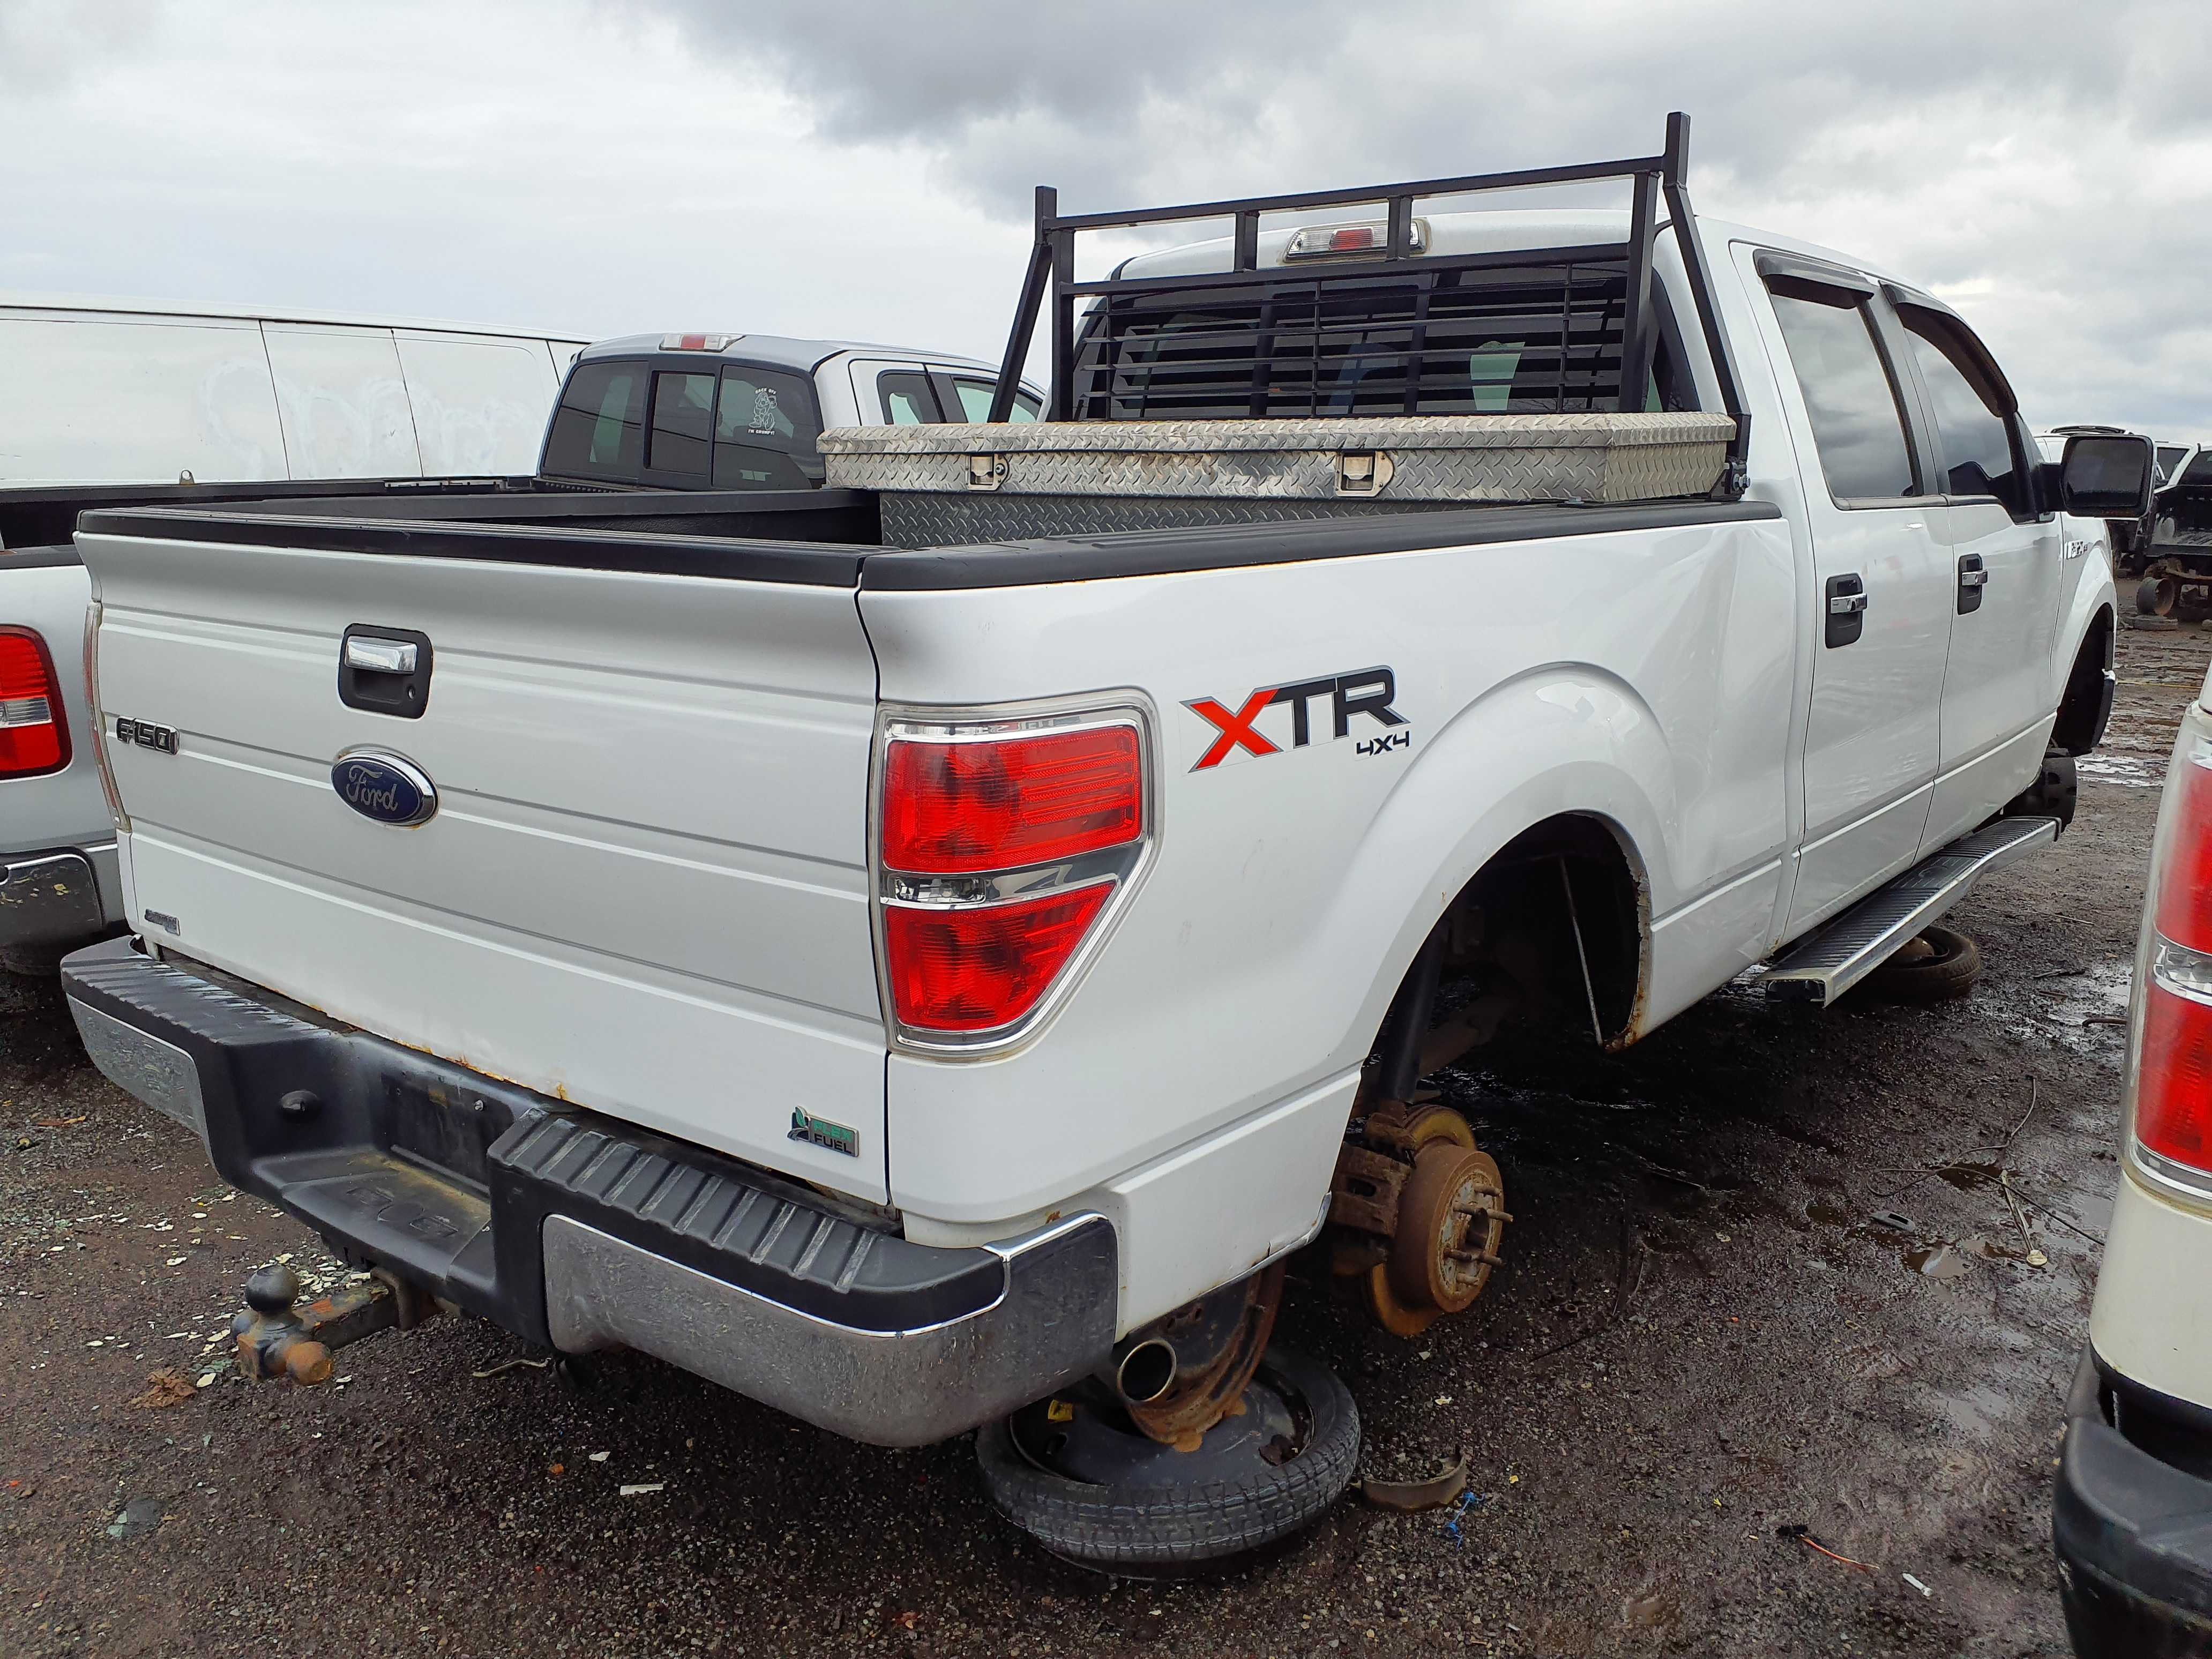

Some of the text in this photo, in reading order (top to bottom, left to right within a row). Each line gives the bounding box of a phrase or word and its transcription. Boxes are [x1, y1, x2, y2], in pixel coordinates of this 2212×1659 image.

[116, 717, 177, 755] F-150
[1179, 664, 1412, 774] XTR
[346, 764, 399, 811] Ford
[813, 1133, 852, 1154] FUEL
